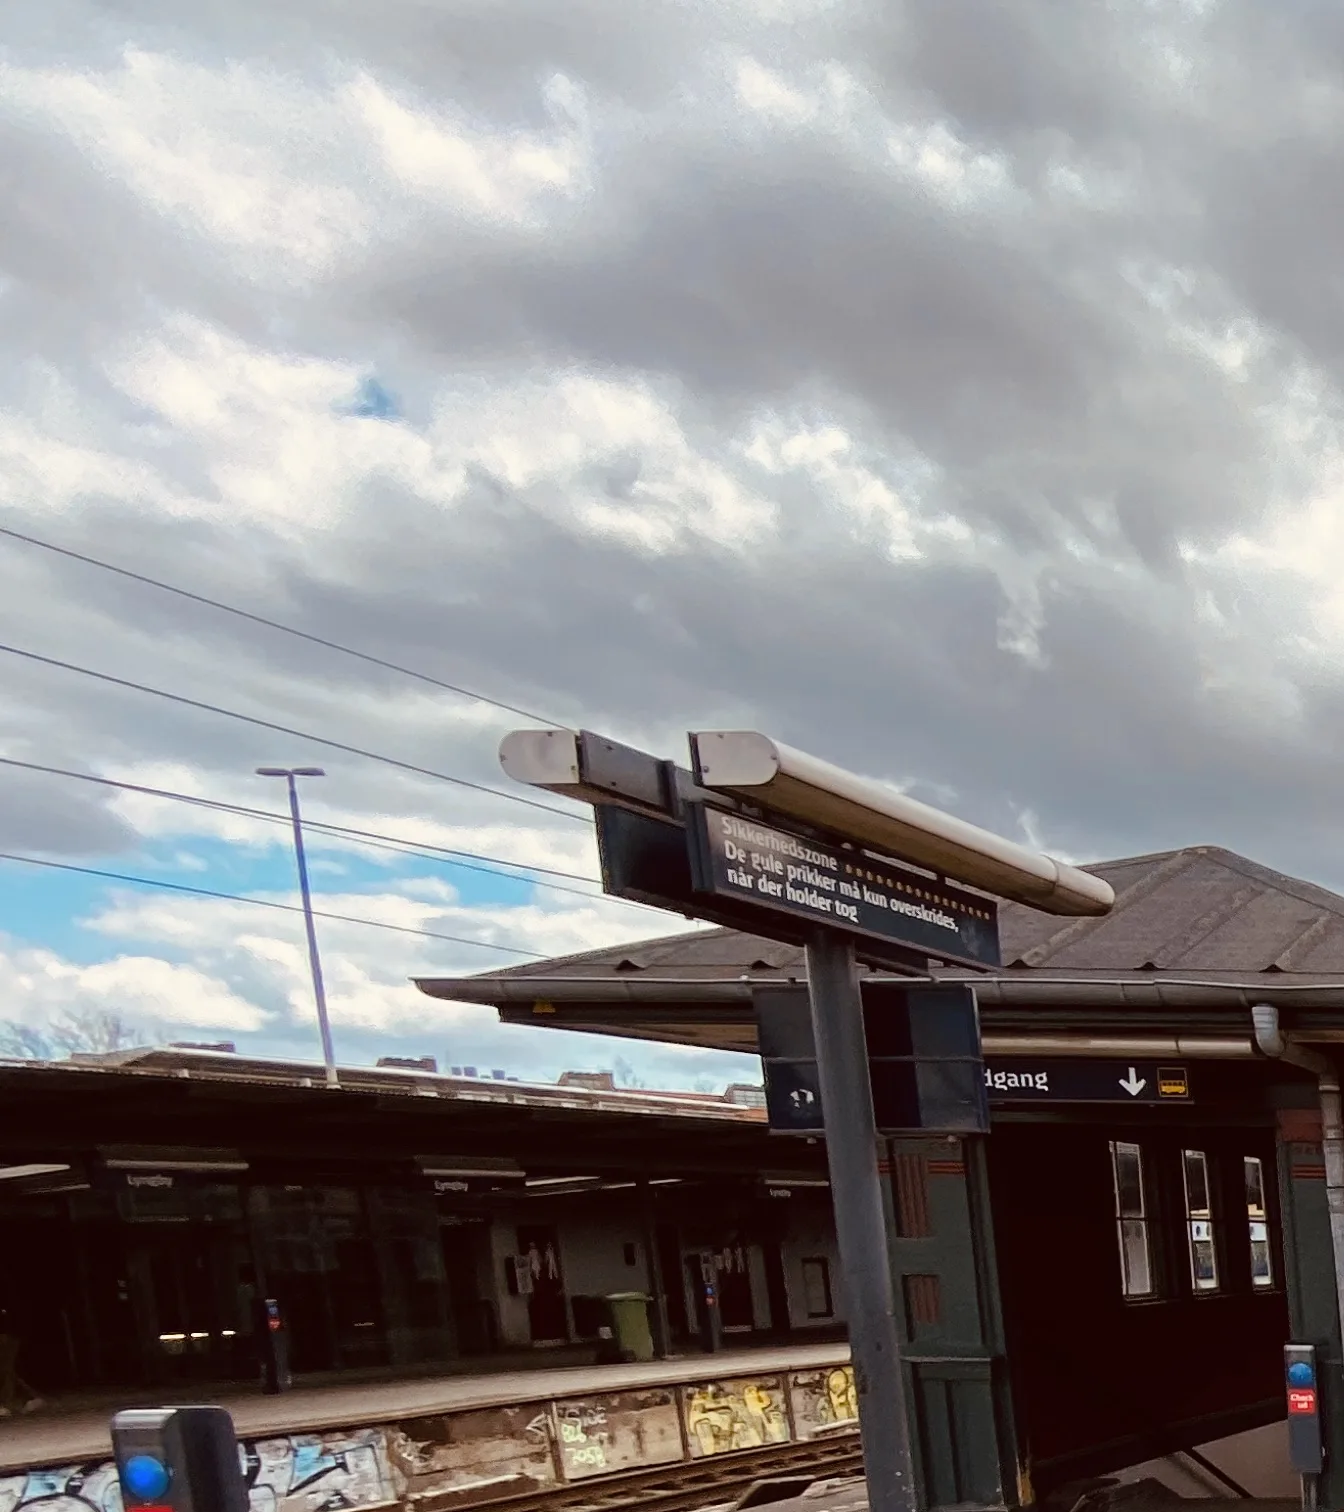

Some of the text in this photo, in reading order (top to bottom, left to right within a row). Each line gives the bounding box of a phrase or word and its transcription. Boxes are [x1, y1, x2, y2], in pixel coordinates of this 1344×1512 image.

[721, 816, 838, 872] Sikkerhedszone
[724, 839, 959, 933] De gule prikker må kun overskrides,
[727, 866, 860, 924] når der holder tog
[984, 1068, 1049, 1091] dgang
